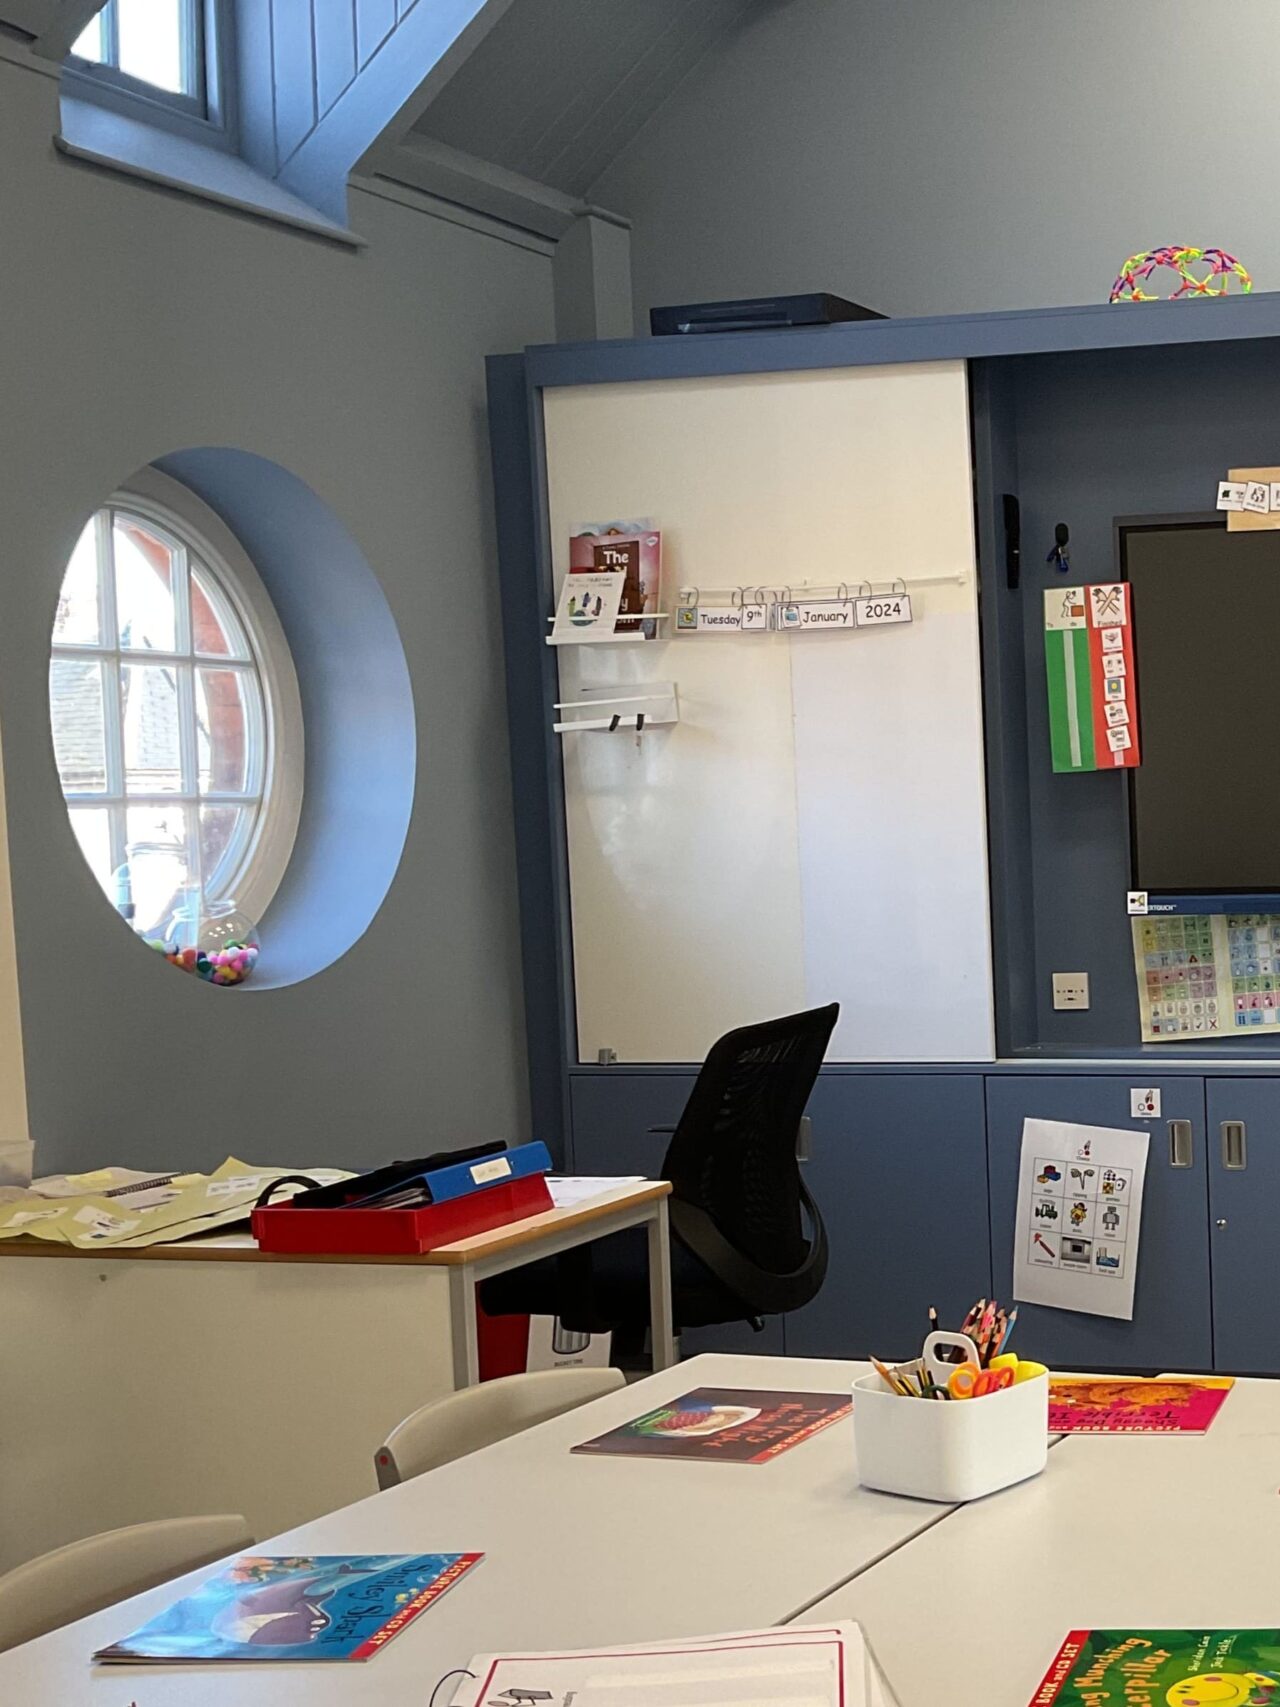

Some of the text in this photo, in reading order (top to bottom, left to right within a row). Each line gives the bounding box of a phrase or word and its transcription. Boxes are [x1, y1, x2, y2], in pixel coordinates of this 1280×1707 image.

[603, 550, 629, 565] The
[803, 611, 848, 625] January
[865, 602, 902, 619] 2024
[701, 611, 762, 627] Tuesday 9th
[1084, 1410, 1180, 1419] Terrible
[430, 1561, 472, 1589] PICTURE
[321, 1564, 432, 1643] Smiley Shark
[409, 1590, 438, 1608] BOOK
[386, 1620, 403, 1629] CD
[368, 1631, 392, 1645] SET
[1061, 1643, 1080, 1658] SET
[1056, 1660, 1071, 1669] CD
[1073, 1638, 1152, 1687] Munching
[1120, 1649, 1171, 1707] erpillar
[1036, 1682, 1059, 1704] BOOK
